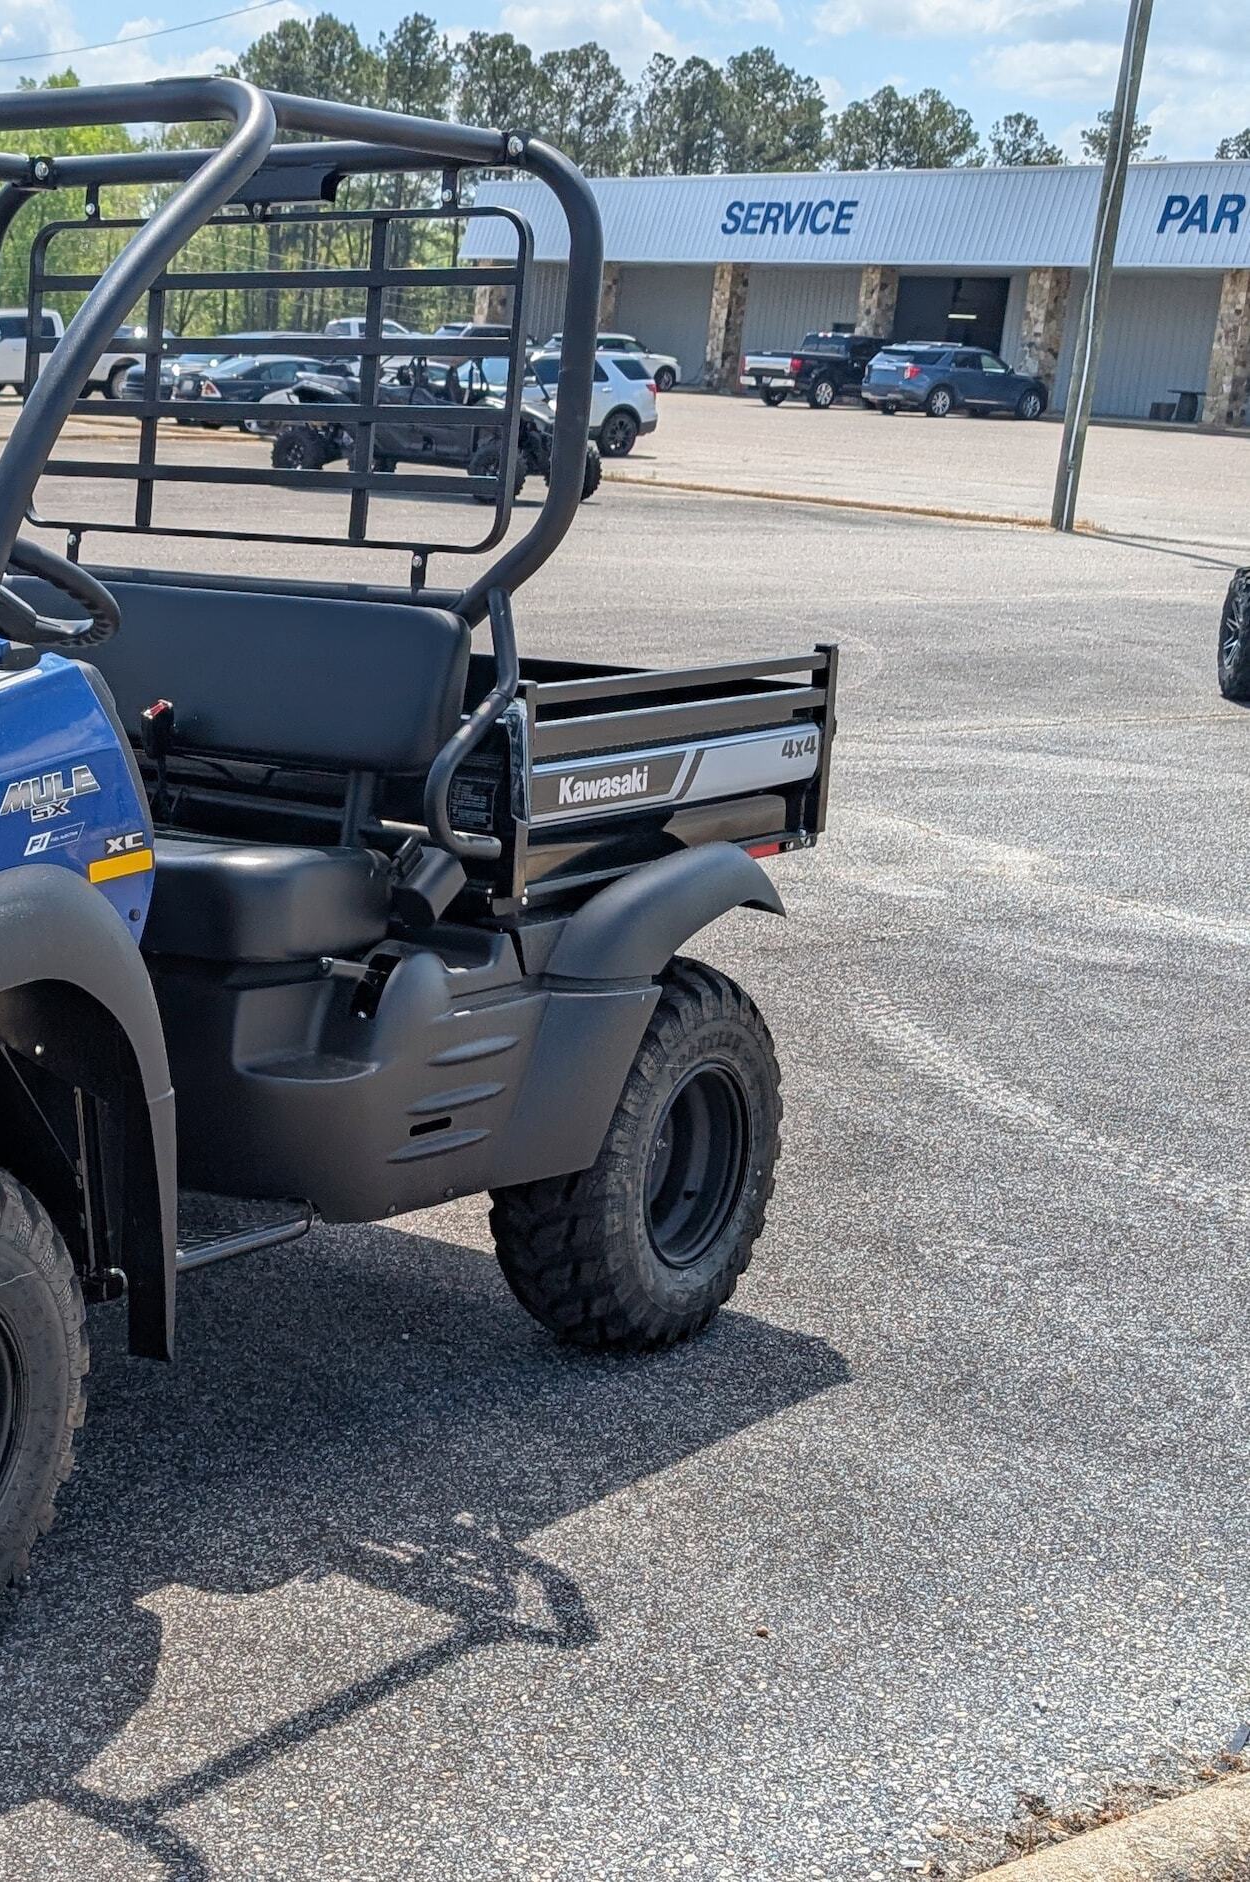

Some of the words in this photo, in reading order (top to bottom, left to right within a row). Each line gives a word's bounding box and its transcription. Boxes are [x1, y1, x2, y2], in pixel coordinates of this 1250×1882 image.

[720, 200, 858, 236] SERVICE
[781, 735, 817, 759] 4x4
[558, 765, 649, 805] Kawasaki
[31, 799, 71, 823] SX
[106, 832, 144, 855] XC
